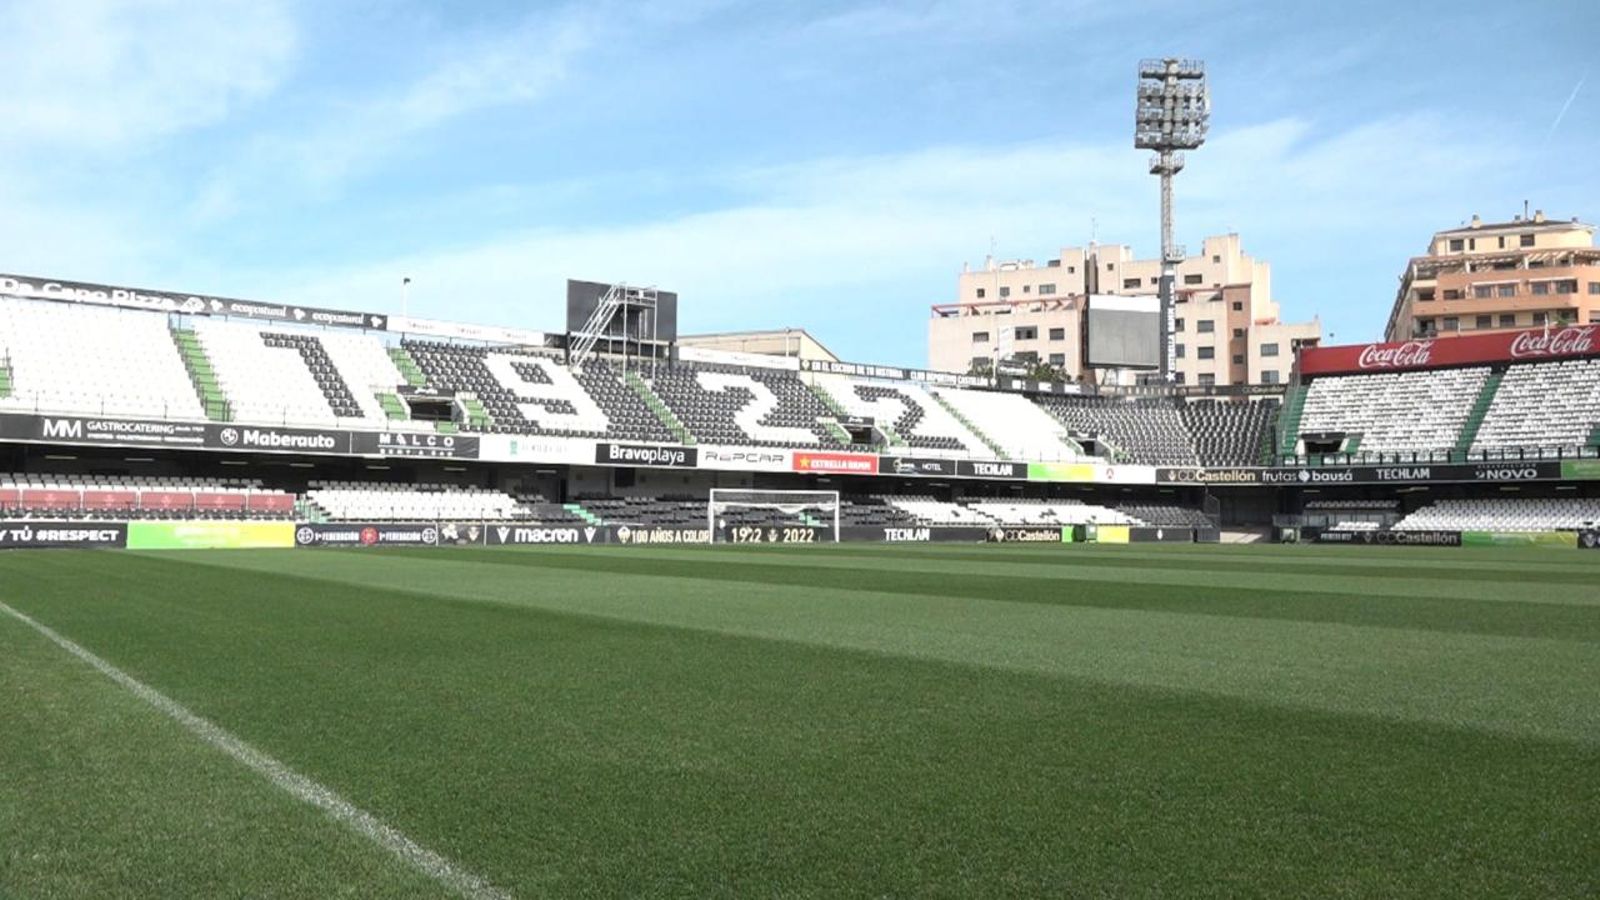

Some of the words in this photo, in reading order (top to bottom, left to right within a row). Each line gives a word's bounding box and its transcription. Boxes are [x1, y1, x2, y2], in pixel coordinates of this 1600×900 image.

[42, 283, 108, 302] Capo
[112, 289, 175, 309] Pizza
[43, 418, 82, 438] MM
[86, 421, 175, 435] GASTROCATERING
[243, 429, 336, 449] Maberauto
[379, 433, 455, 447] MALCO
[609, 444, 686, 466] Bravoplaya
[1262, 468, 1297, 482] frutas
[1312, 468, 1353, 482] bausá
[1376, 467, 1431, 480] TECHLAM
[1486, 468, 1538, 480] NOVO
[36, 529, 119, 542] #RESPECT
[514, 527, 579, 543] macron
[731, 528, 762, 543] 1922
[783, 528, 814, 543] 2022
